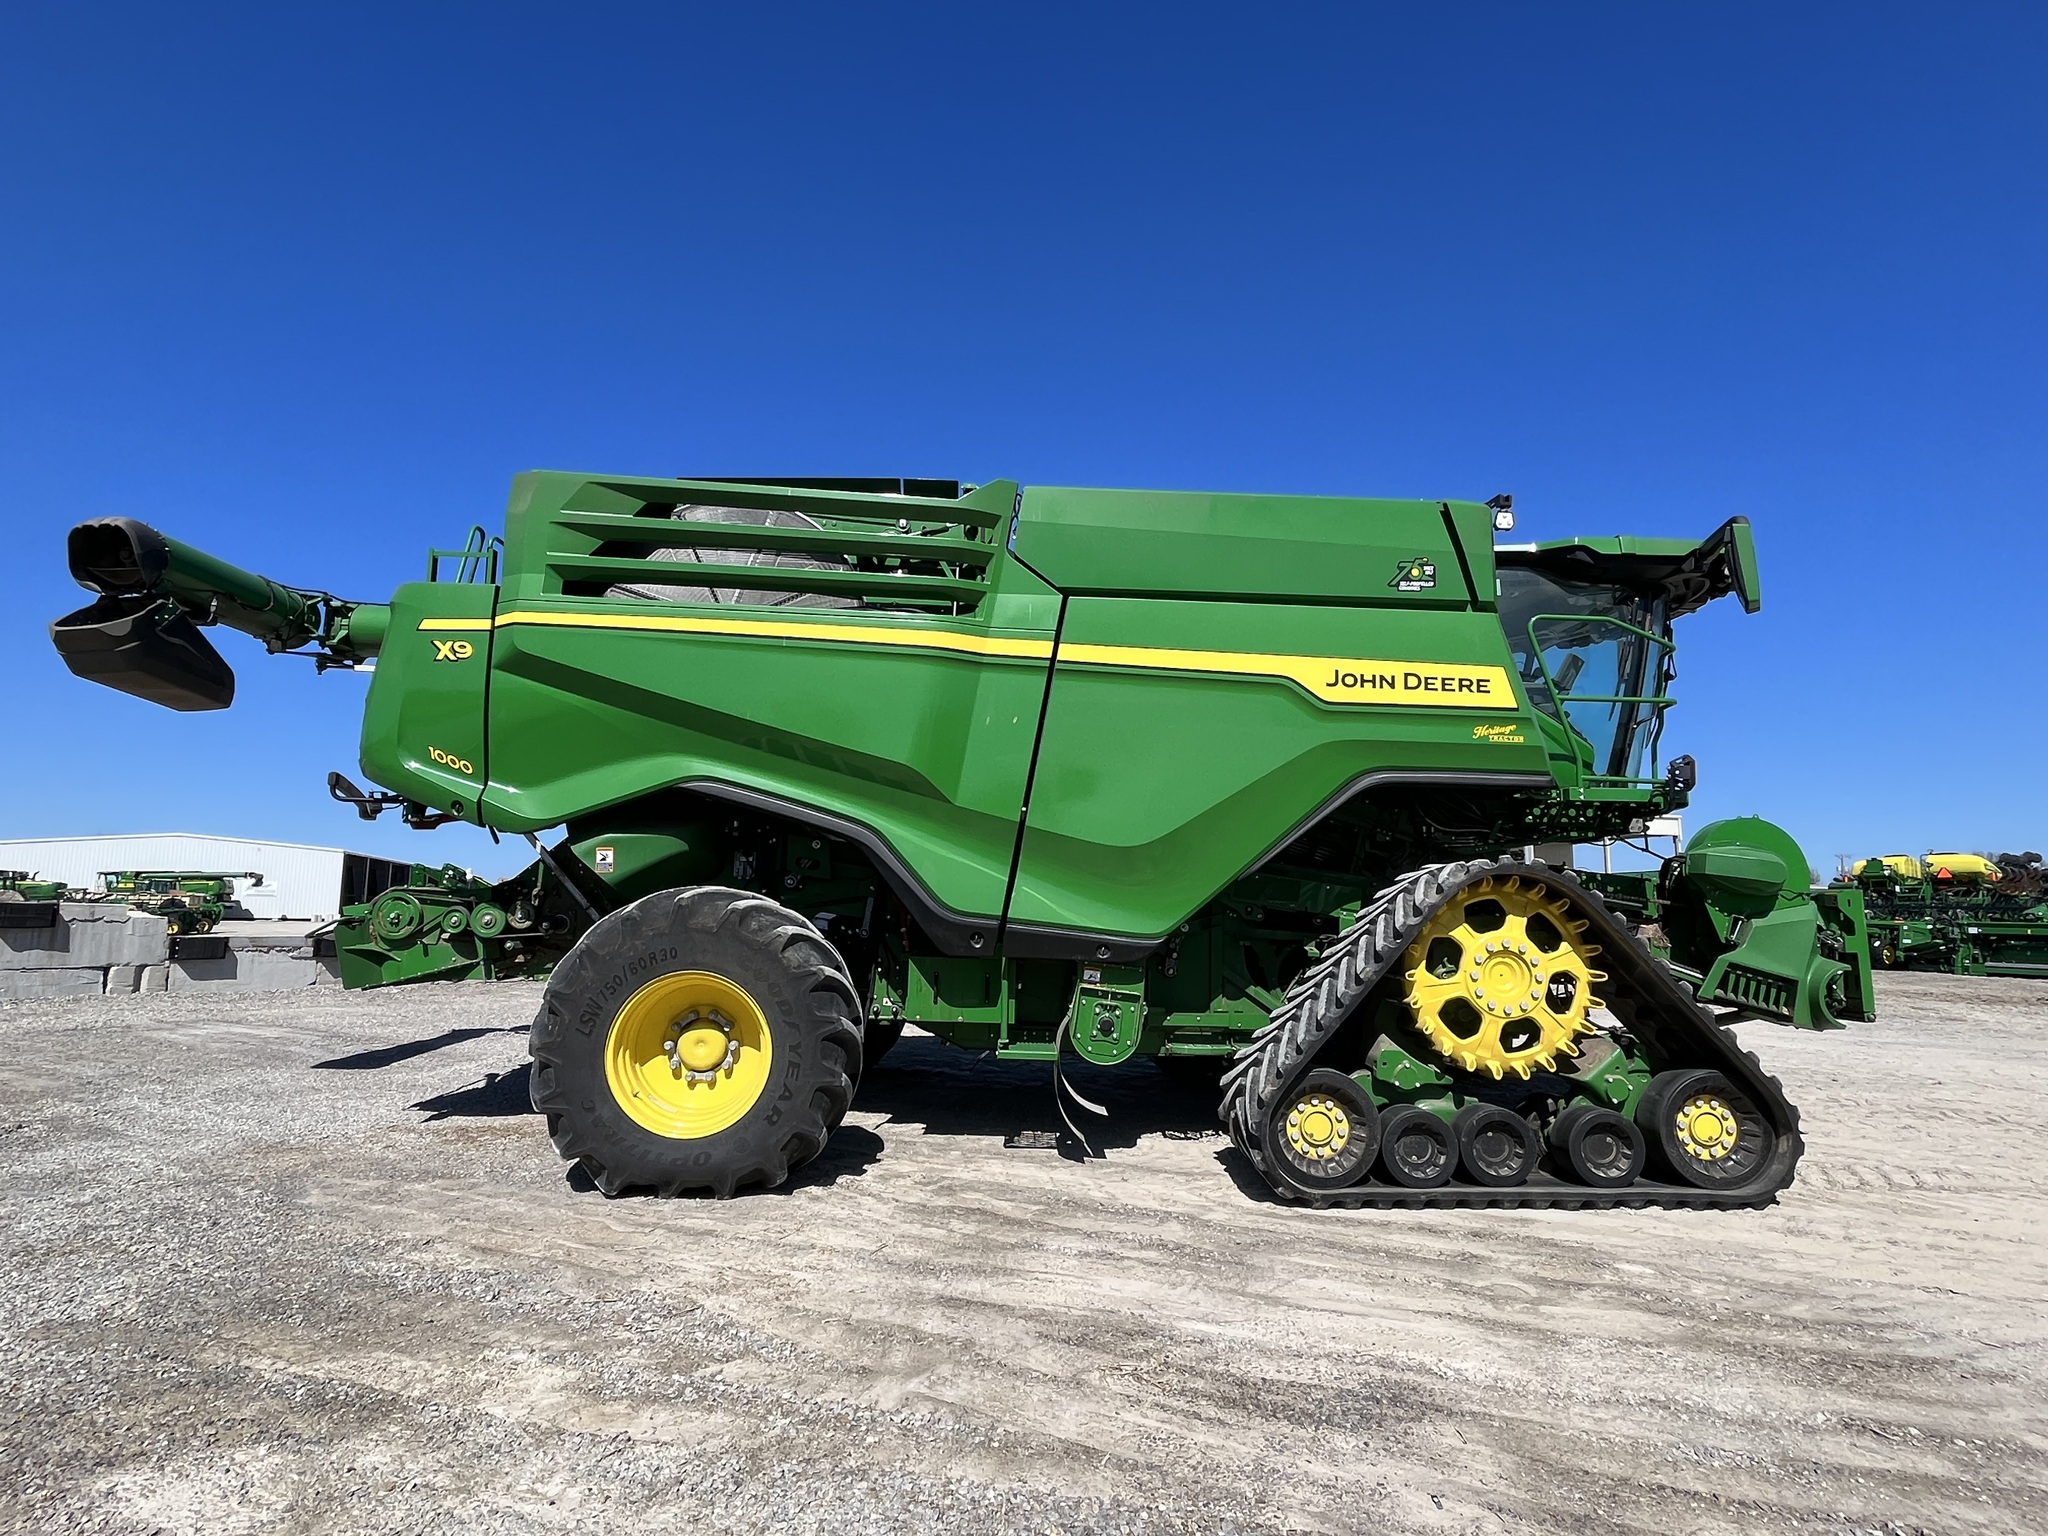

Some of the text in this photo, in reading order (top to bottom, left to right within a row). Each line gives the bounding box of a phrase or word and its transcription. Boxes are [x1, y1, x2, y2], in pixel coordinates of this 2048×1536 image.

[430, 640, 473, 661] X9
[1326, 669, 1491, 694] JOHN DEERE
[1472, 724, 1517, 739] Heritage
[1488, 734, 1524, 743] TRACTOR
[427, 745, 473, 775] 1000
